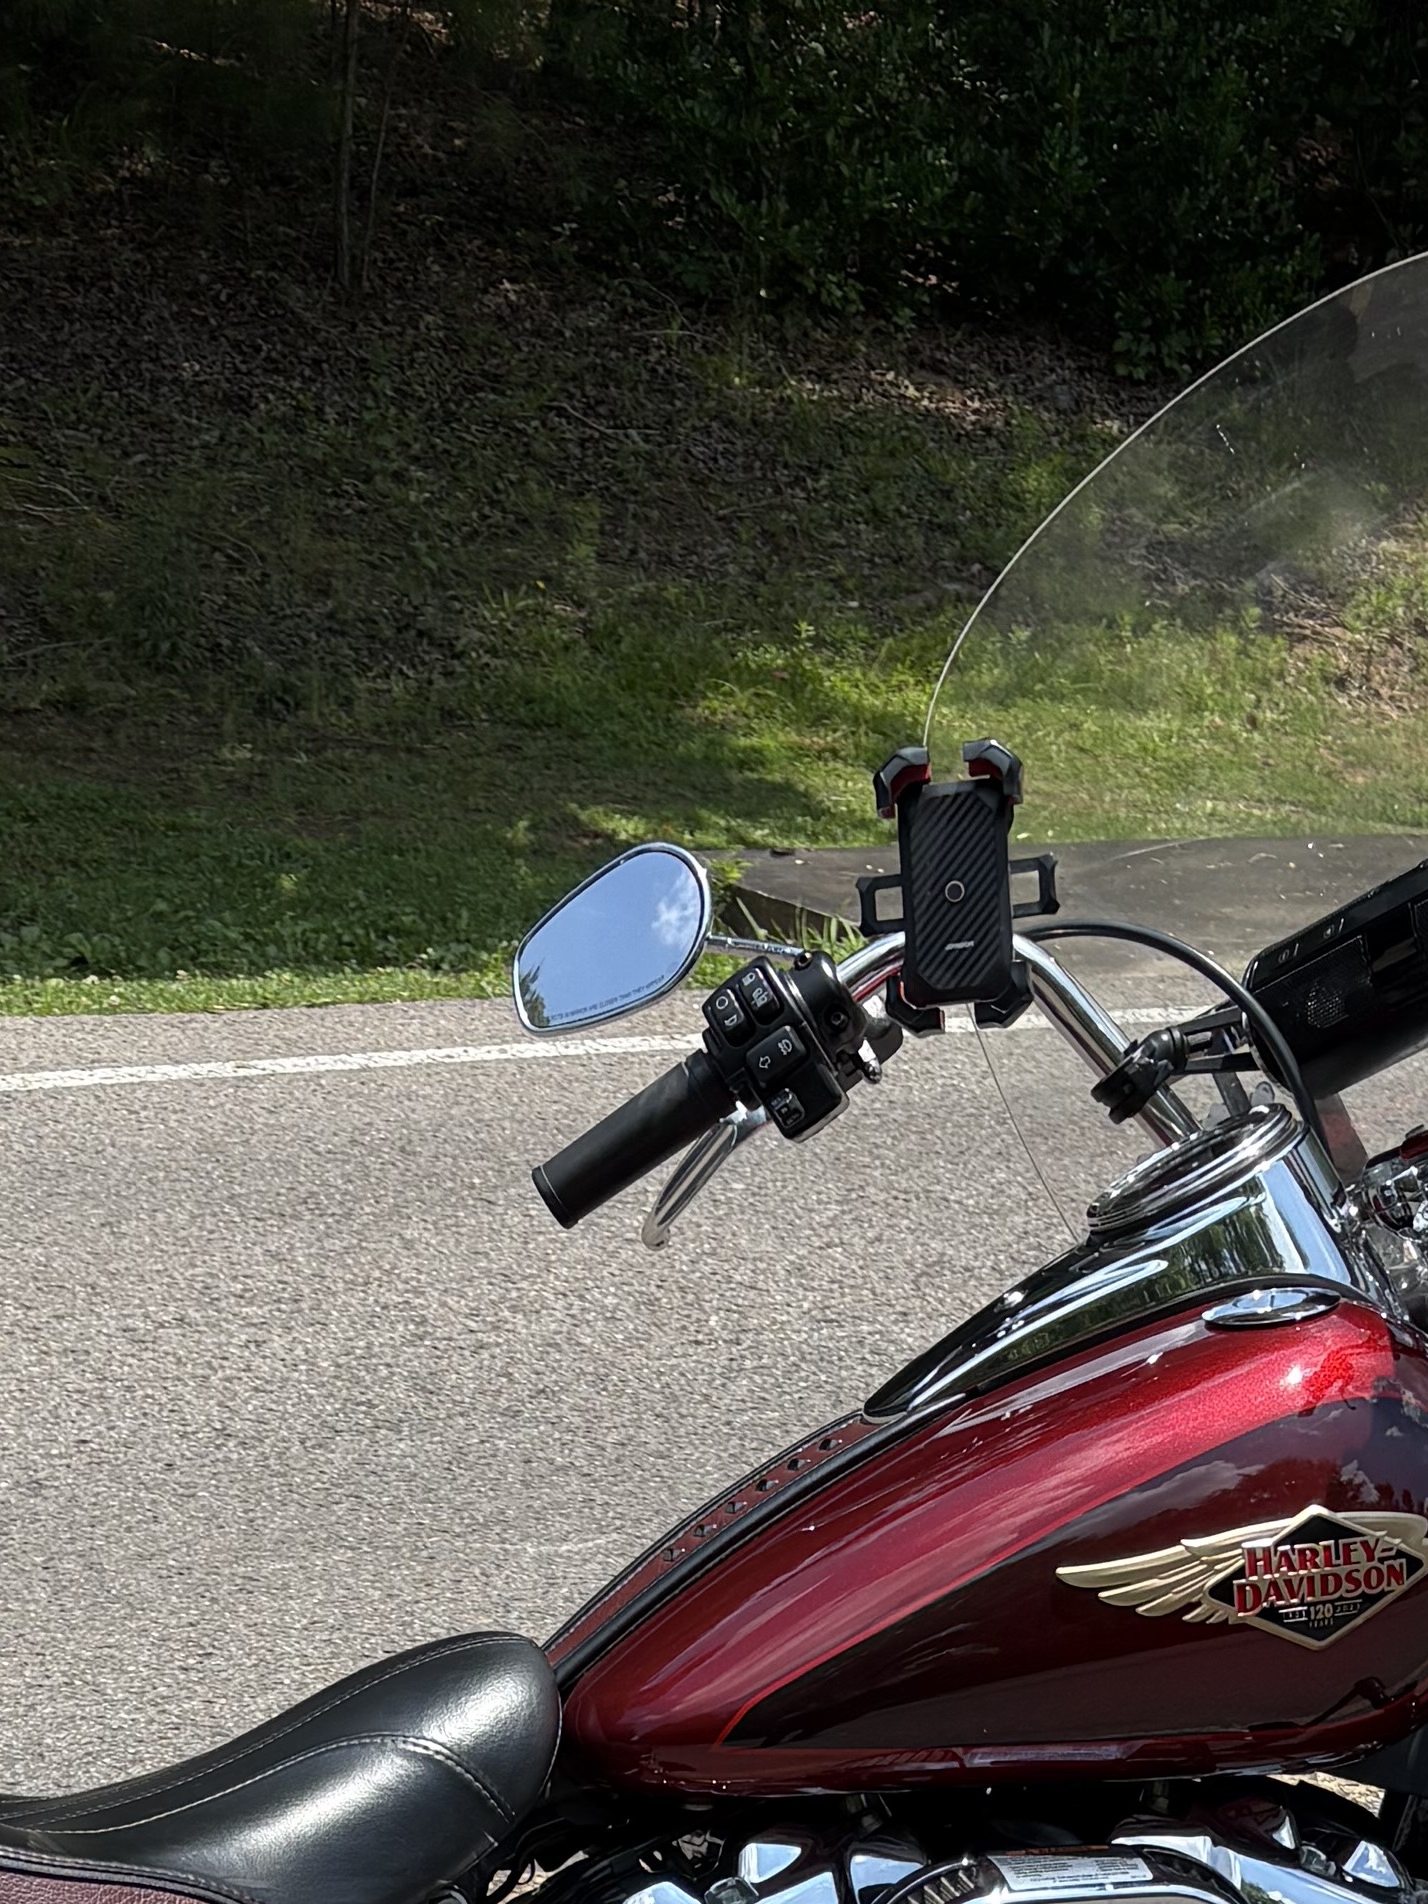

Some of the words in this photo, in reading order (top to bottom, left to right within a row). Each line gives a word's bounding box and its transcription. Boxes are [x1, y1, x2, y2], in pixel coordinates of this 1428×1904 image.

[1241, 1536, 1398, 1581] HARLEY-
[1233, 1558, 1407, 1617] DAVIDSON
[1309, 1602, 1334, 1620] 120
